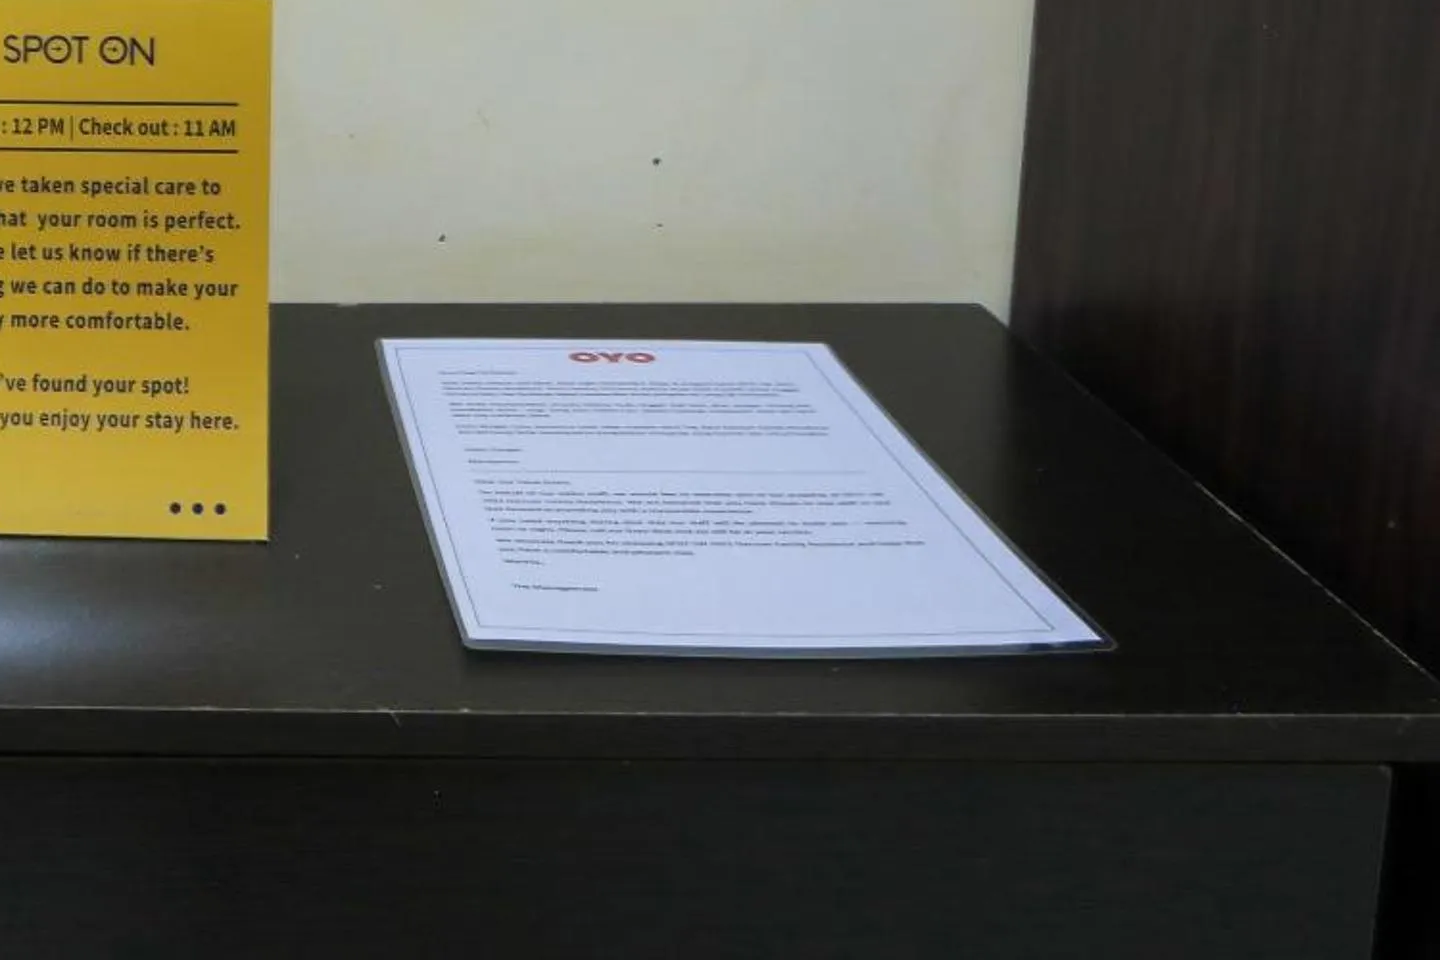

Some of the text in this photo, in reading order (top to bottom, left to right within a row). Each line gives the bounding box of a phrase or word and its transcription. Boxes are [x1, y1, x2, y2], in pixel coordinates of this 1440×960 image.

[3, 33, 156, 67] SPOT ON
[11, 117, 34, 135] 12
[37, 117, 65, 135] PM
[78, 116, 135, 136] Check
[137, 119, 170, 137] out
[183, 119, 205, 138] 11
[208, 119, 236, 137] AM
[20, 175, 76, 194] taken
[79, 176, 150, 198] special
[154, 181, 197, 196] care
[201, 178, 222, 196] to
[37, 213, 83, 232] your
[87, 213, 138, 229] room
[143, 209, 160, 229] is
[164, 210, 241, 233] perfect.
[10, 242, 38, 261] let
[41, 246, 64, 261] us
[68, 243, 122, 262] know
[127, 243, 142, 262] if
[145, 244, 215, 264] there's
[10, 279, 39, 295] we
[41, 280, 77, 295] can
[81, 276, 107, 296] do
[110, 279, 132, 296] to
[135, 277, 189, 297] make
[193, 283, 239, 301] your
[10, 314, 61, 329] more
[64, 310, 190, 332] comfortable.
[568, 352, 656, 363] OYO
[31, 373, 89, 393] found
[91, 378, 137, 398] your
[141, 376, 190, 398] spot!
[0, 411, 35, 431] you
[38, 408, 91, 433] enjoy
[96, 413, 141, 433] your
[144, 411, 185, 434] stay
[189, 410, 239, 431] here.
